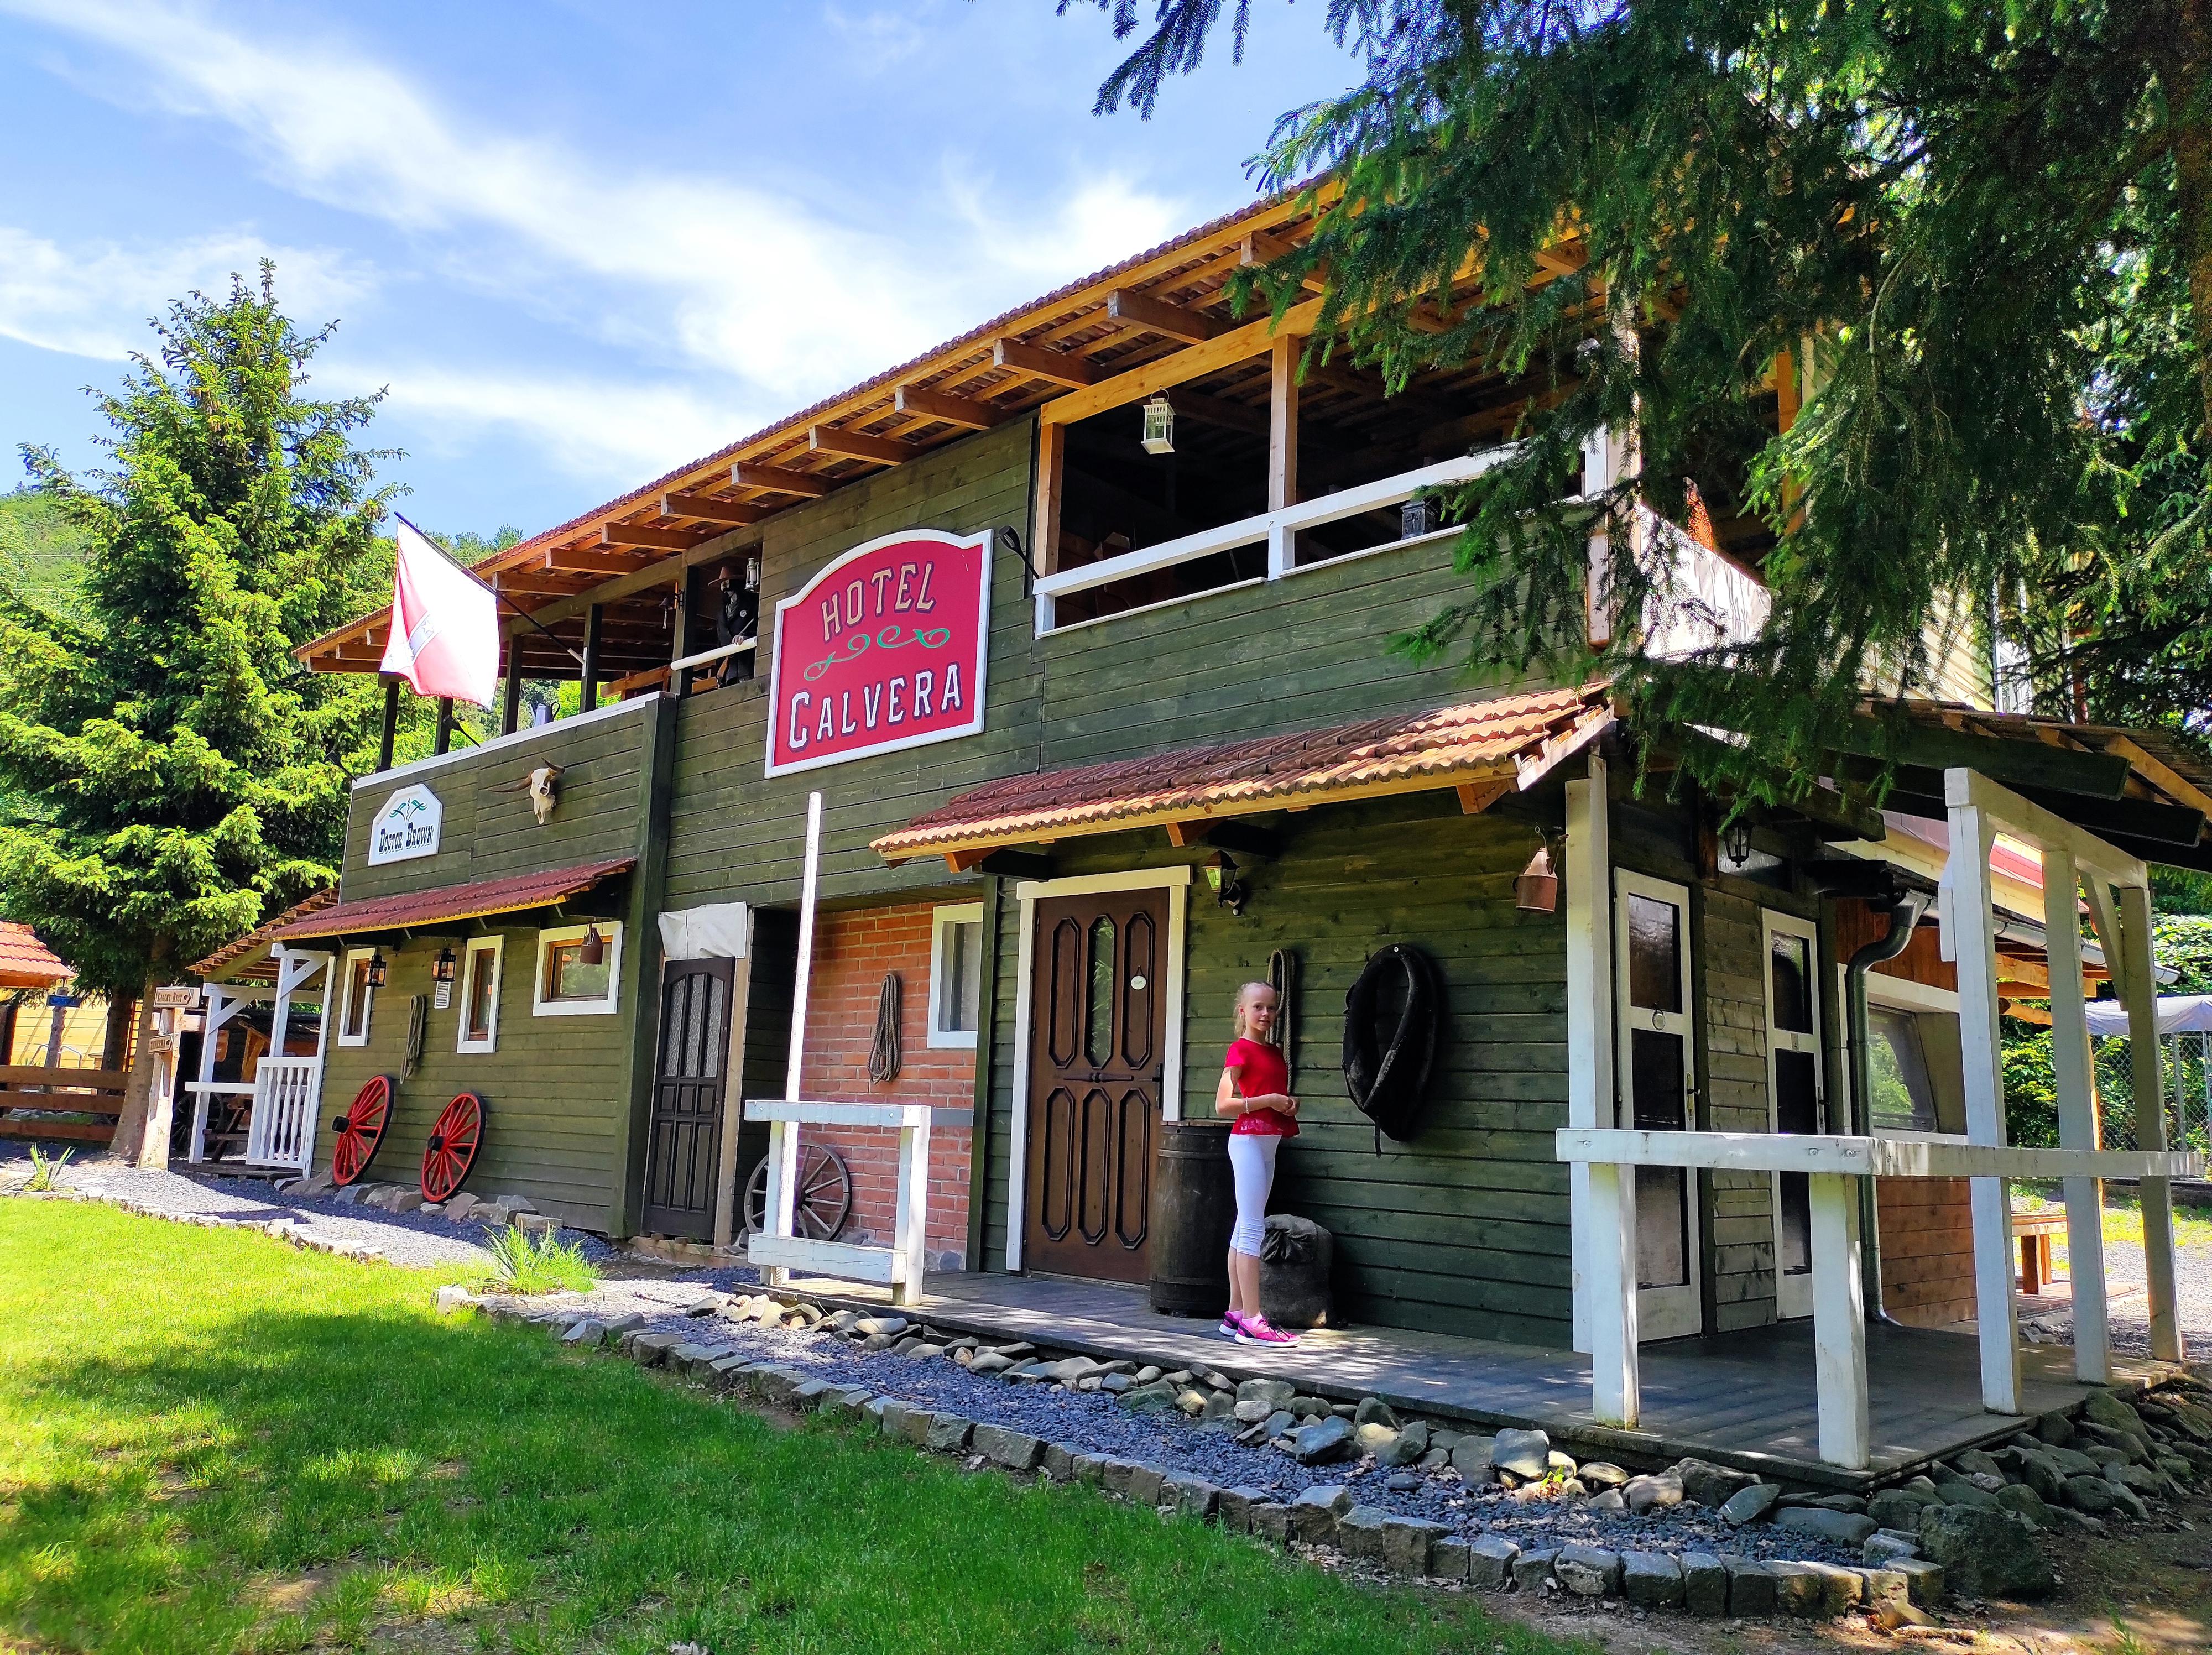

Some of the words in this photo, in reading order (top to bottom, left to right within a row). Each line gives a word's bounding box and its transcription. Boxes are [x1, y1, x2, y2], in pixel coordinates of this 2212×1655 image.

[821, 561, 936, 644] HOTEL
[787, 662, 963, 753] CALVERA
[379, 828, 403, 854] DOCTOR
[406, 822, 434, 849] BROWN
